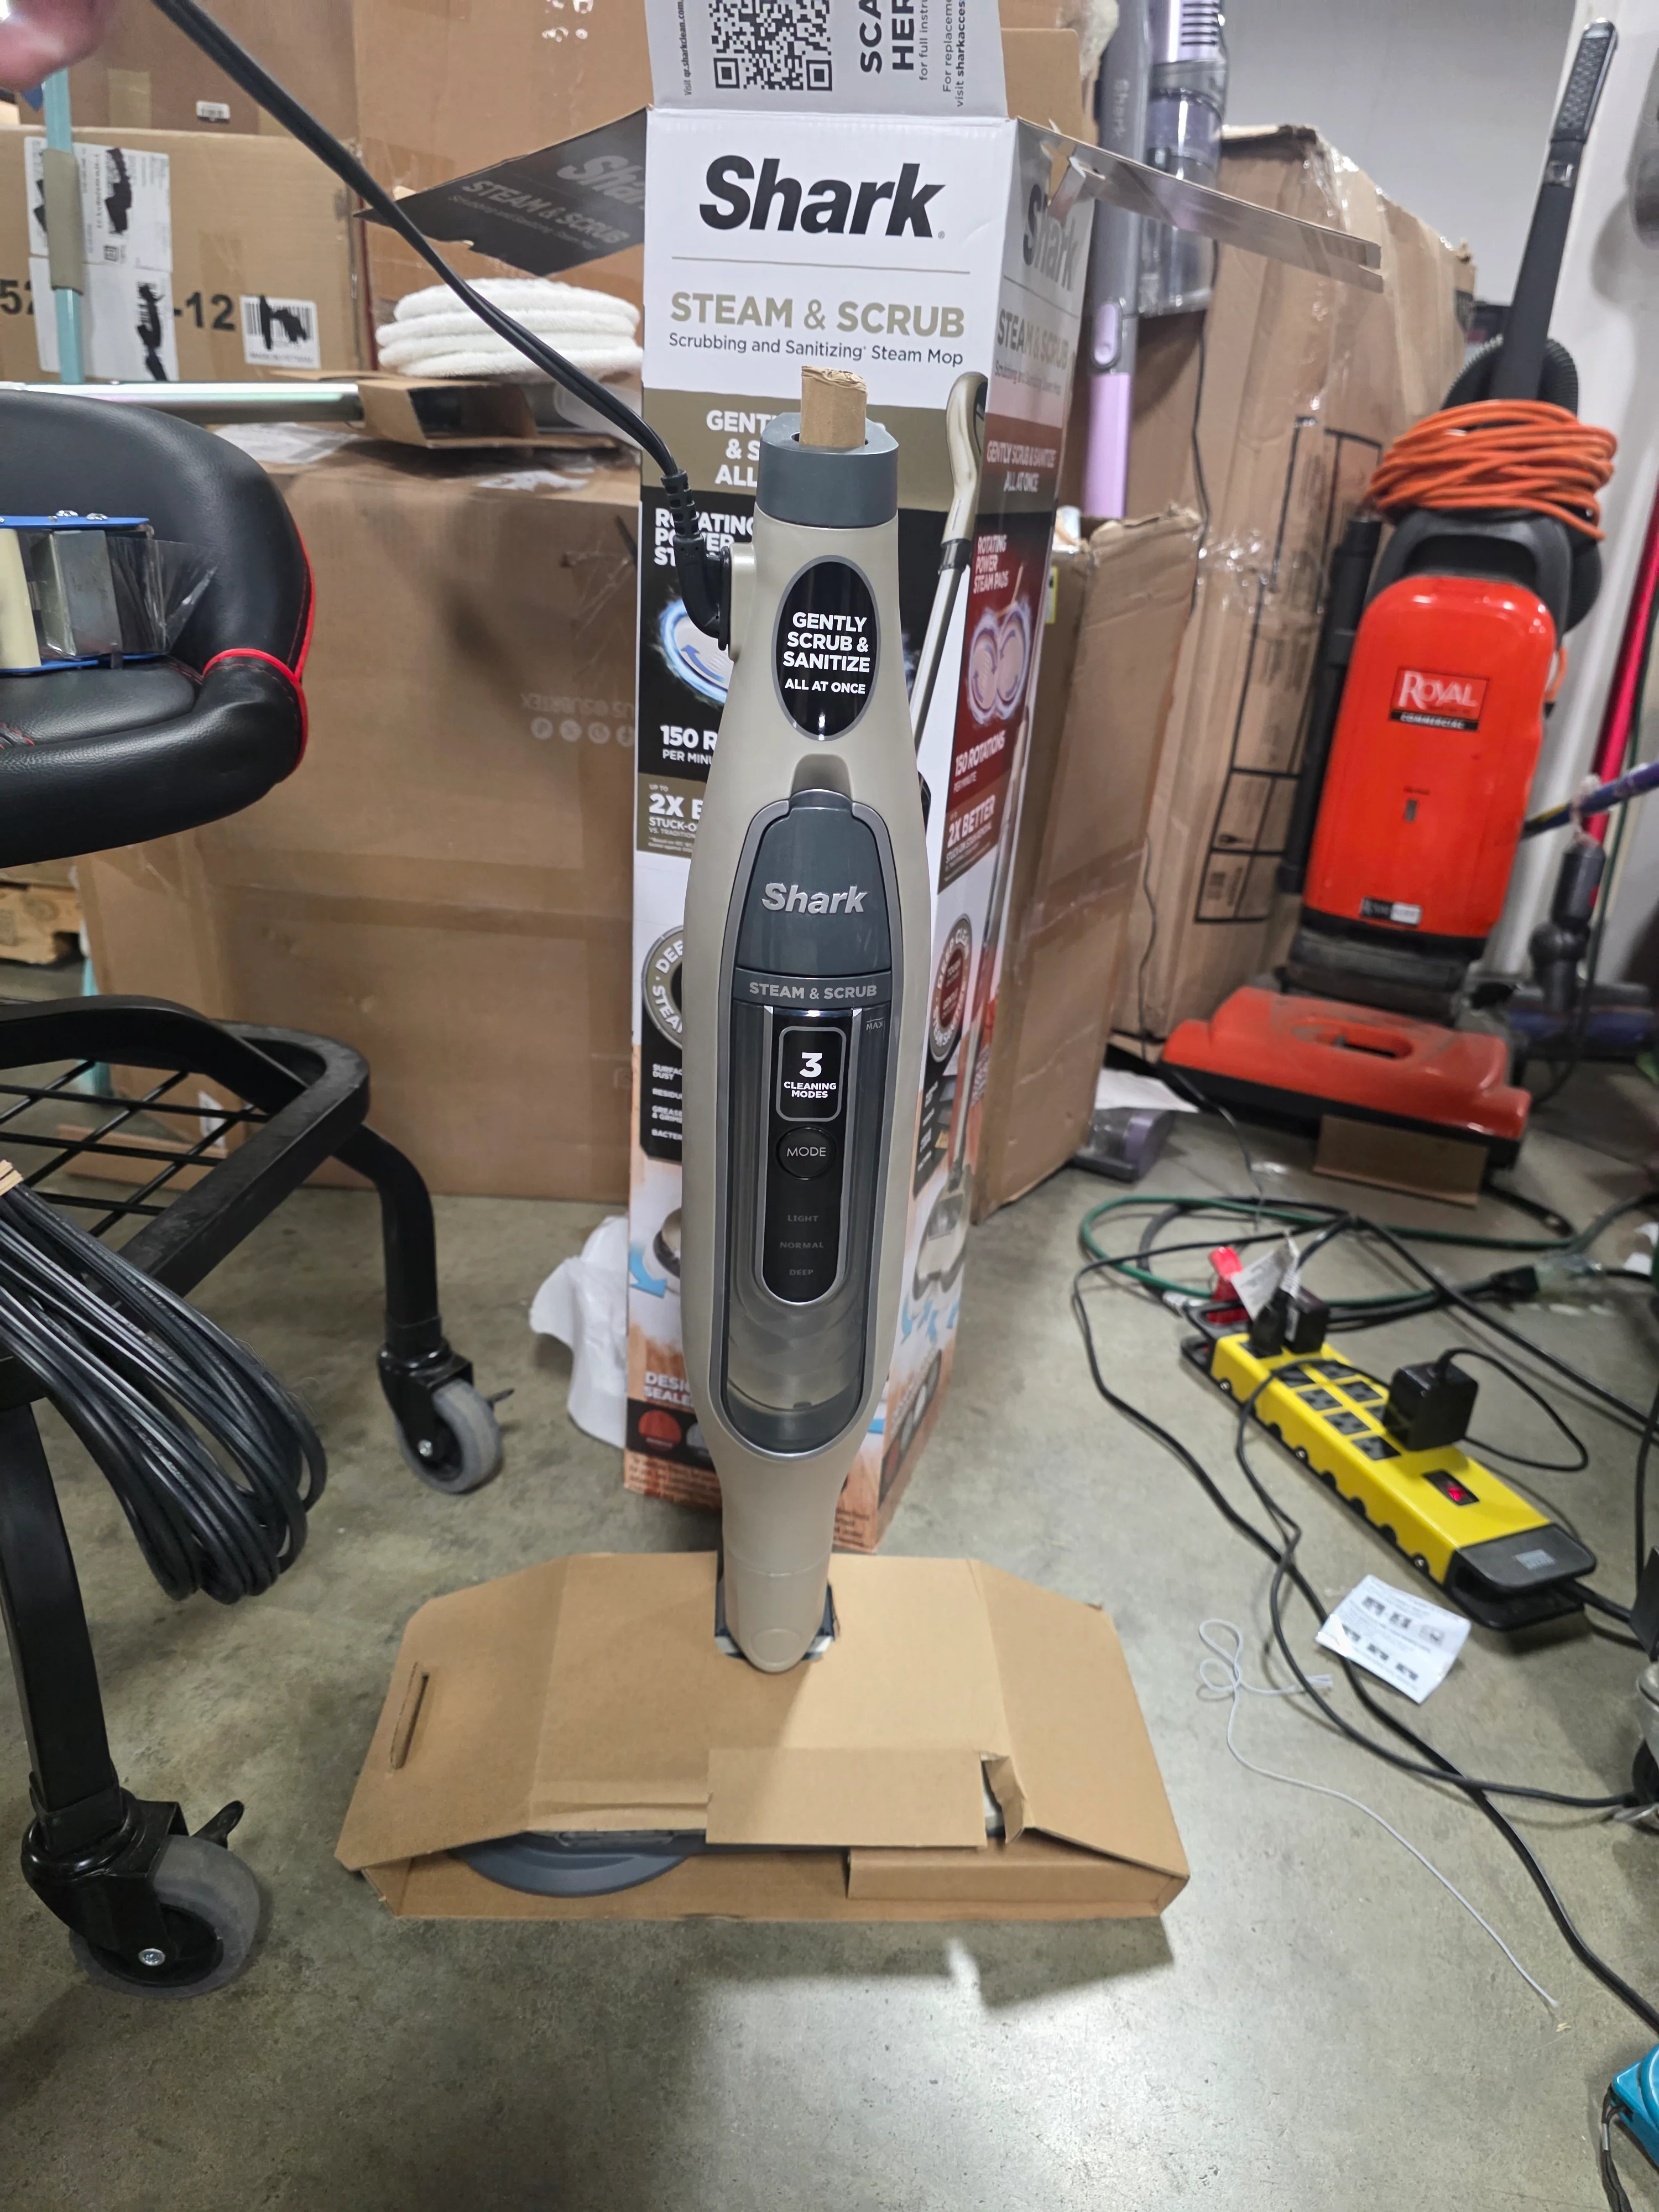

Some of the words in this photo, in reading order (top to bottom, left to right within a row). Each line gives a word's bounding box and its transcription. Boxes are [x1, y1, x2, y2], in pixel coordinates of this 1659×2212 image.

[677, 0, 691, 77] qr.sharkclean.com
[919, 38, 928, 58] full
[919, 62, 928, 81] for
[942, 70, 952, 92] For
[684, 79, 692, 96] Visit
[955, 81, 964, 107] visit
[699, 154, 946, 238] Shark
[462, 180, 552, 213] STEAM
[555, 212, 630, 244] SCRUB
[1022, 183, 1077, 291] Shark
[670, 291, 793, 328] STEAM
[804, 299, 826, 330] &
[836, 301, 965, 338] SCRUB
[997, 308, 1034, 357] STEAM
[669, 332, 748, 353] Scrubbing
[752, 337, 781, 354] and
[872, 345, 922, 363] Steam
[927, 348, 964, 367] Mop
[706, 410, 774, 434] GENT
[726, 438, 742, 460] &
[714, 465, 758, 487] ALL
[978, 534, 1008, 555] ROTATING
[975, 554, 999, 575] POWER
[973, 573, 994, 594] STEAM
[792, 612, 867, 633] GENTLY
[787, 632, 853, 651] SCRUB
[857, 637, 869, 653] &
[782, 651, 871, 673] SANITIZE
[785, 679, 809, 690] ALL
[811, 680, 828, 692] AT
[831, 682, 866, 695] ONCE
[1398, 670, 1479, 711] ROYAL
[660, 725, 699, 749] 150
[662, 749, 685, 762] PER
[649, 793, 685, 818] 2X
[947, 817, 962, 849] 2X
[962, 794, 996, 838] BETTER
[761, 882, 869, 914] Shark
[749, 982, 805, 999] STEAM
[809, 988, 820, 1000] &
[823, 985, 878, 999] SCRUB
[866, 1021, 884, 1031] MAX
[653, 1071, 674, 1081] DUST
[799, 1052, 823, 1078] 3
[784, 1081, 837, 1091] CLEANING
[791, 1089, 828, 1098] MODES
[786, 1146, 827, 1157] MODE
[787, 1214, 819, 1223] LIGHT
